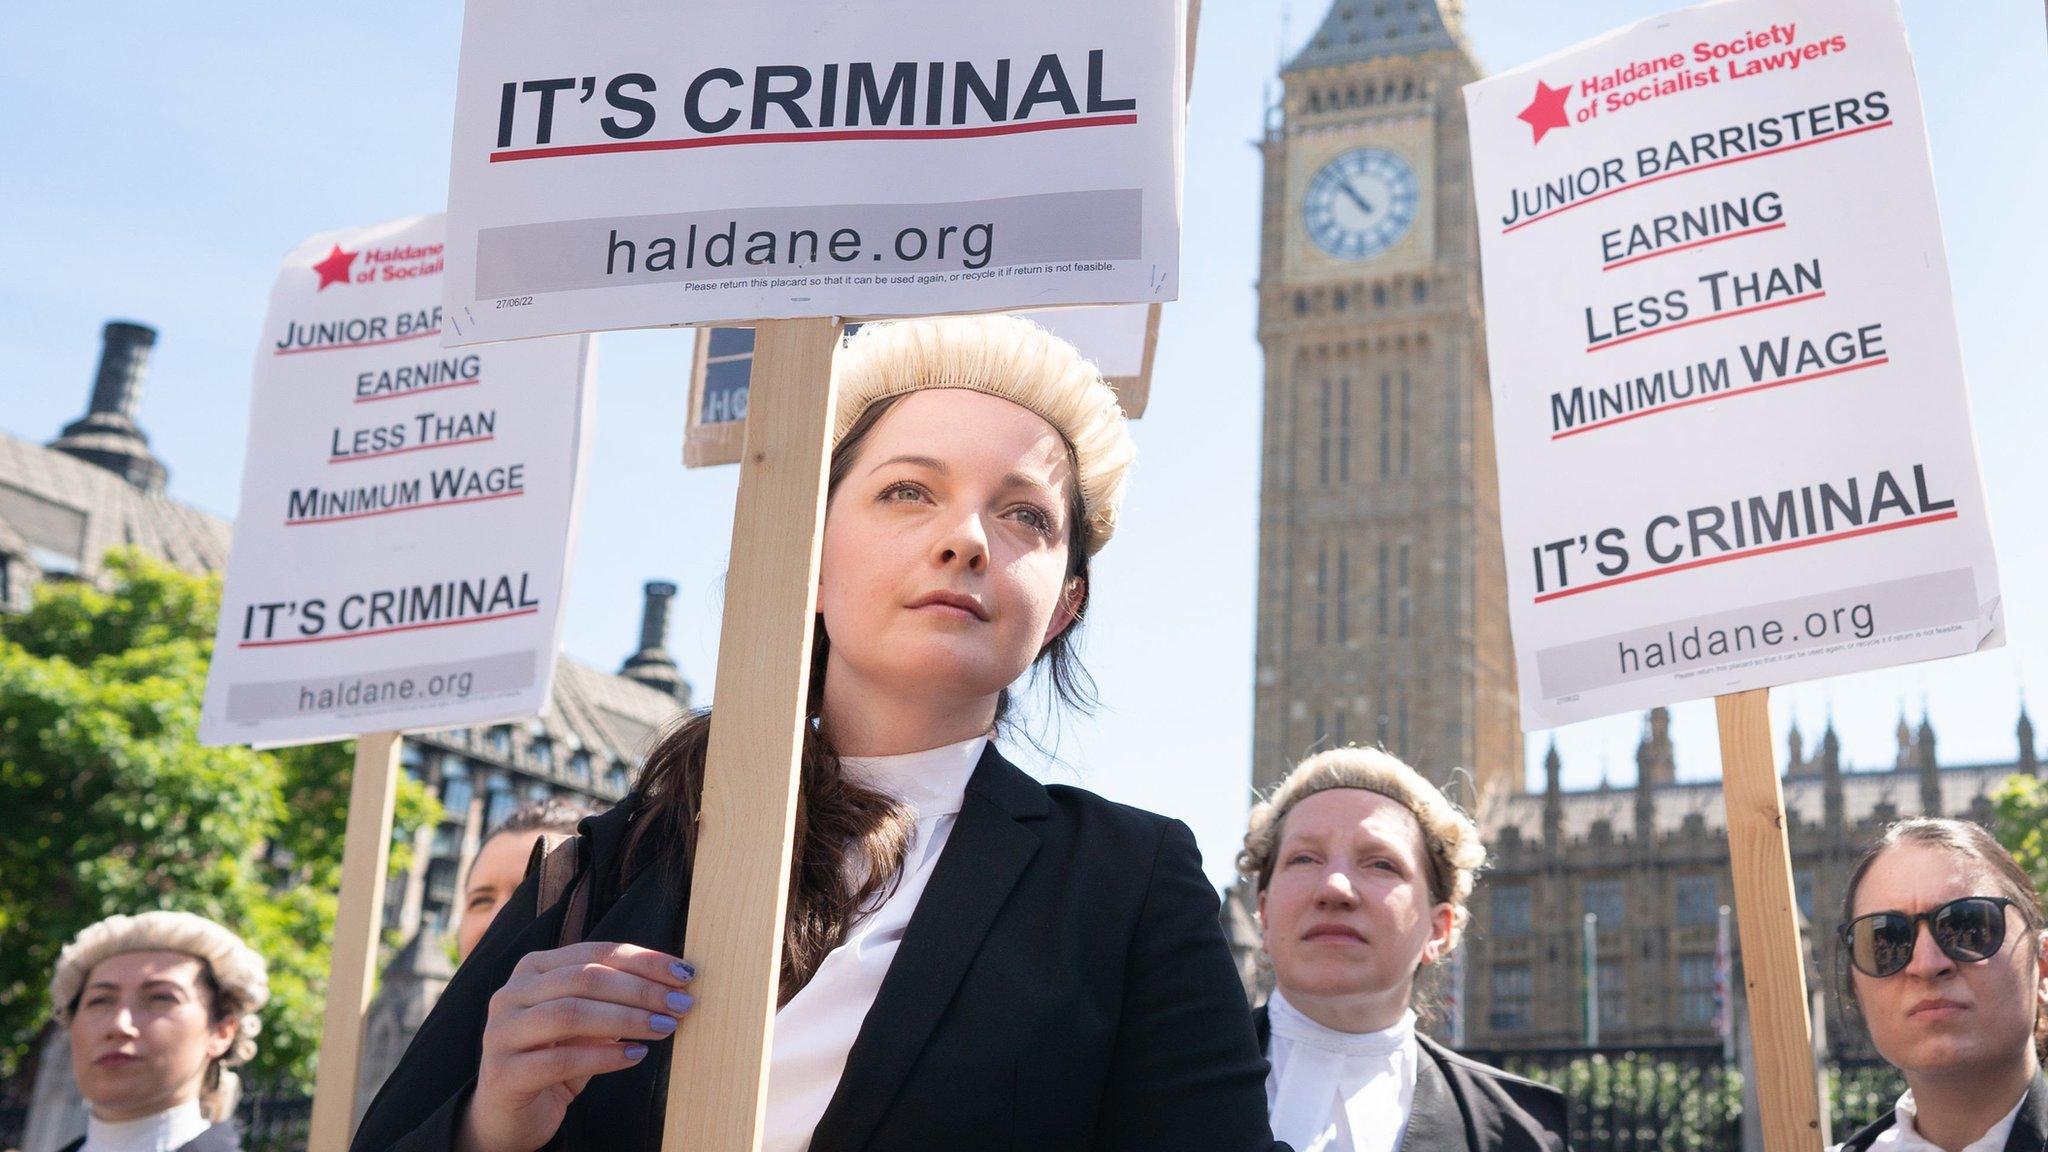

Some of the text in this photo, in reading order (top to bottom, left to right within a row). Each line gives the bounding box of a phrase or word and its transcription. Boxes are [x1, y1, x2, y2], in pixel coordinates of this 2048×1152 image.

[1577, 34, 1847, 123] of Socialist Lawyers
[1581, 22, 1796, 97] Haldane Society
[497, 49, 1137, 148] IT'S CRIMINAL
[1502, 90, 1891, 227] JUNIOR BARRISTERS
[364, 242, 443, 265] Haldane
[606, 221, 994, 275] haldane.org
[1601, 190, 1785, 264] EARNING
[356, 267, 376, 283] of
[496, 296, 533, 309] 27/06/22
[684, 262, 1116, 292] Please return this placard so that it can be used again, or recycle it if return is not feasible.
[1585, 258, 1824, 345] LESS THAN
[277, 317, 387, 350] JUNIOR
[355, 354, 480, 397] EARNING
[1551, 323, 1887, 432] MINIMUM WAGE
[331, 410, 495, 456] LESS THAN
[287, 464, 525, 519] MINIMUM WAGE
[1532, 463, 1955, 593] IT'S CRIMINAL
[242, 573, 539, 640] IT'S CRIMINAL
[1617, 601, 1875, 674] haldane.org
[298, 670, 473, 713] haldane.org
